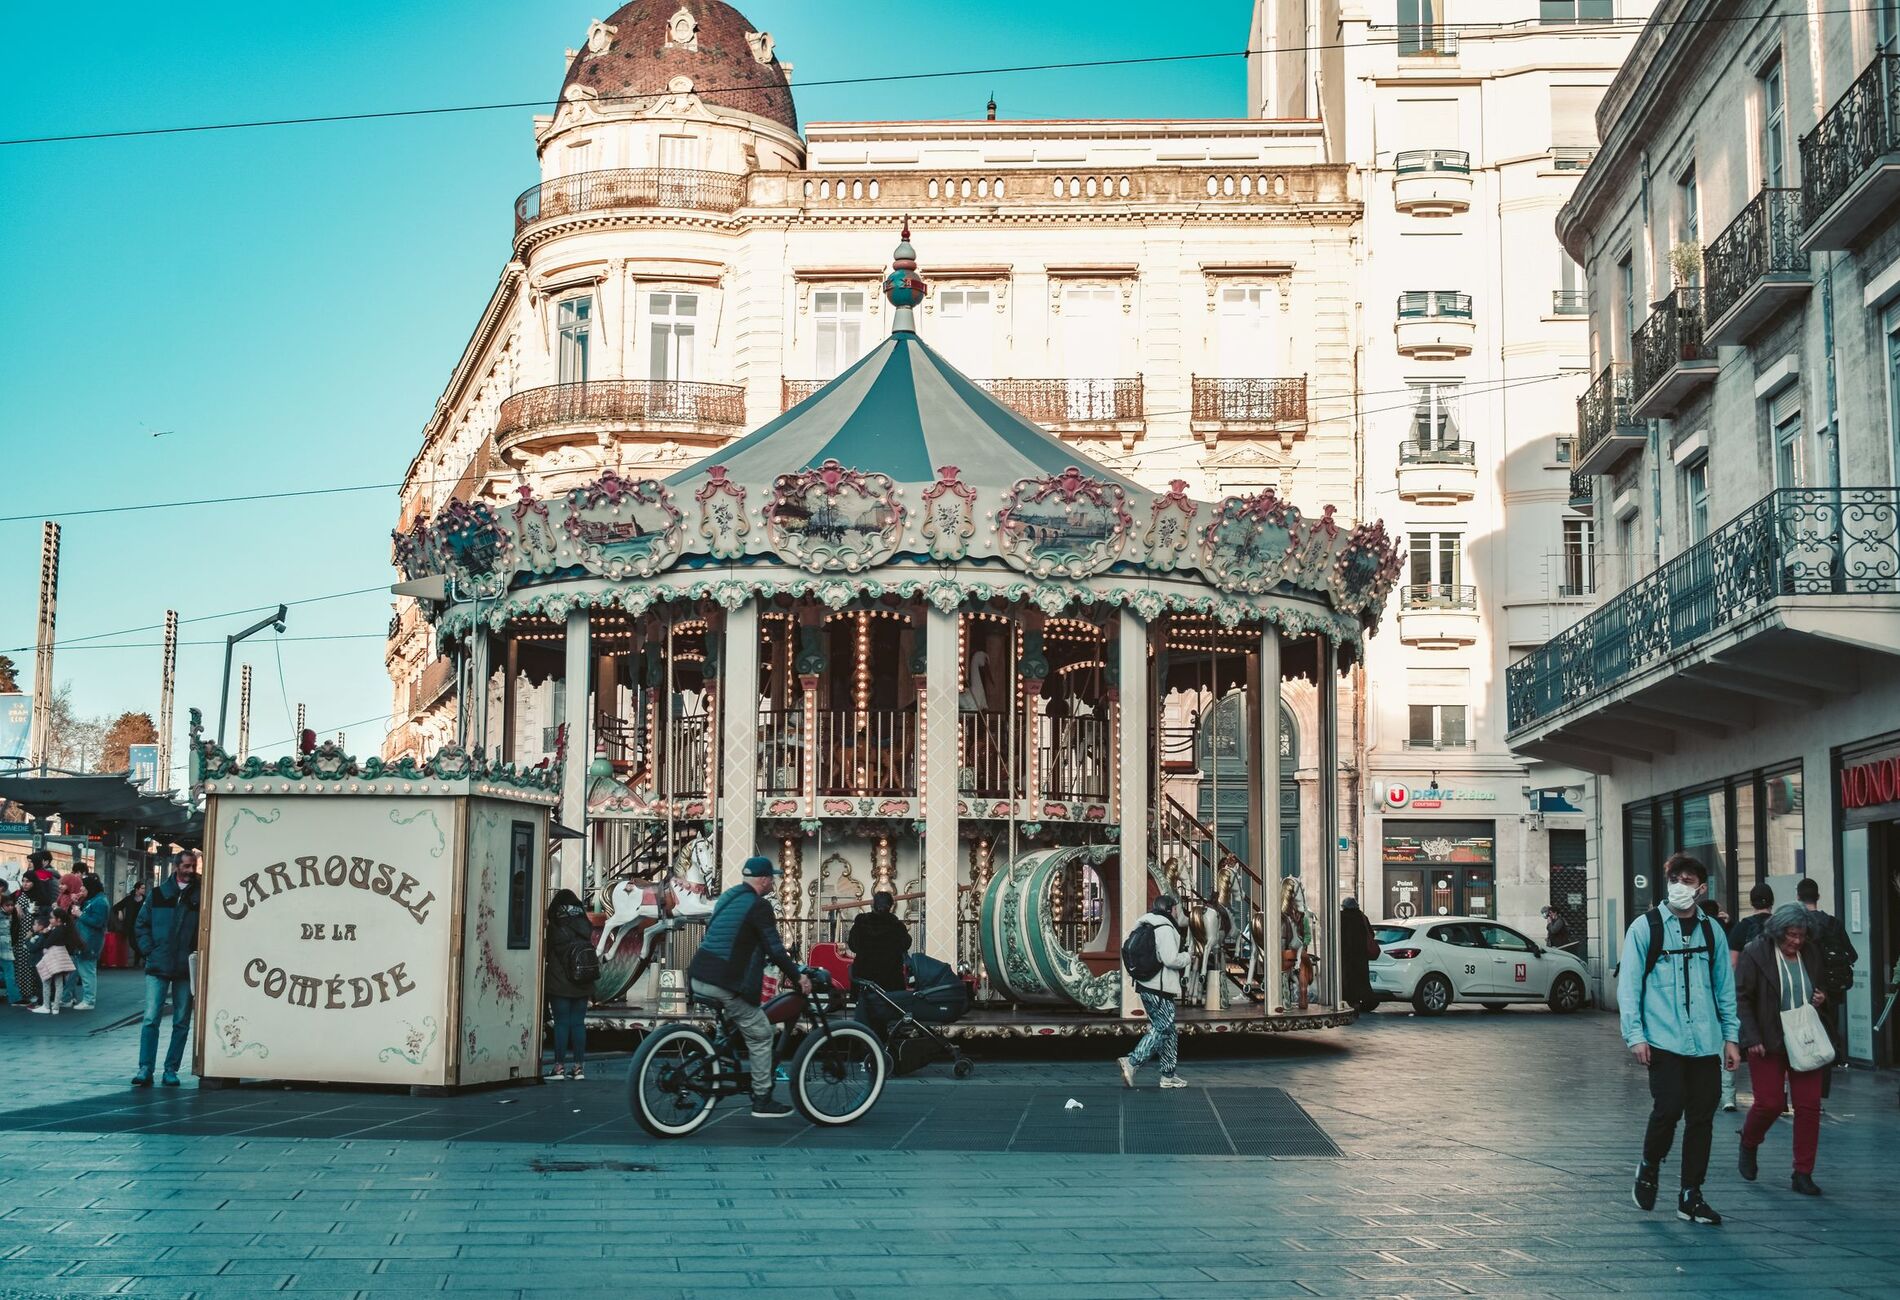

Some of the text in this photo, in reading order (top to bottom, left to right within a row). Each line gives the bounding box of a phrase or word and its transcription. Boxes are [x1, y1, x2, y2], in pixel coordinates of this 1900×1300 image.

[1390, 788, 1496, 802] U DRIVE Piéton
[222, 854, 436, 925] CARROUSEL
[301, 923, 357, 941] DE LA
[1464, 964, 1476, 975] 38
[1516, 965, 1524, 976] N
[243, 957, 416, 1009] COMÉDIE
